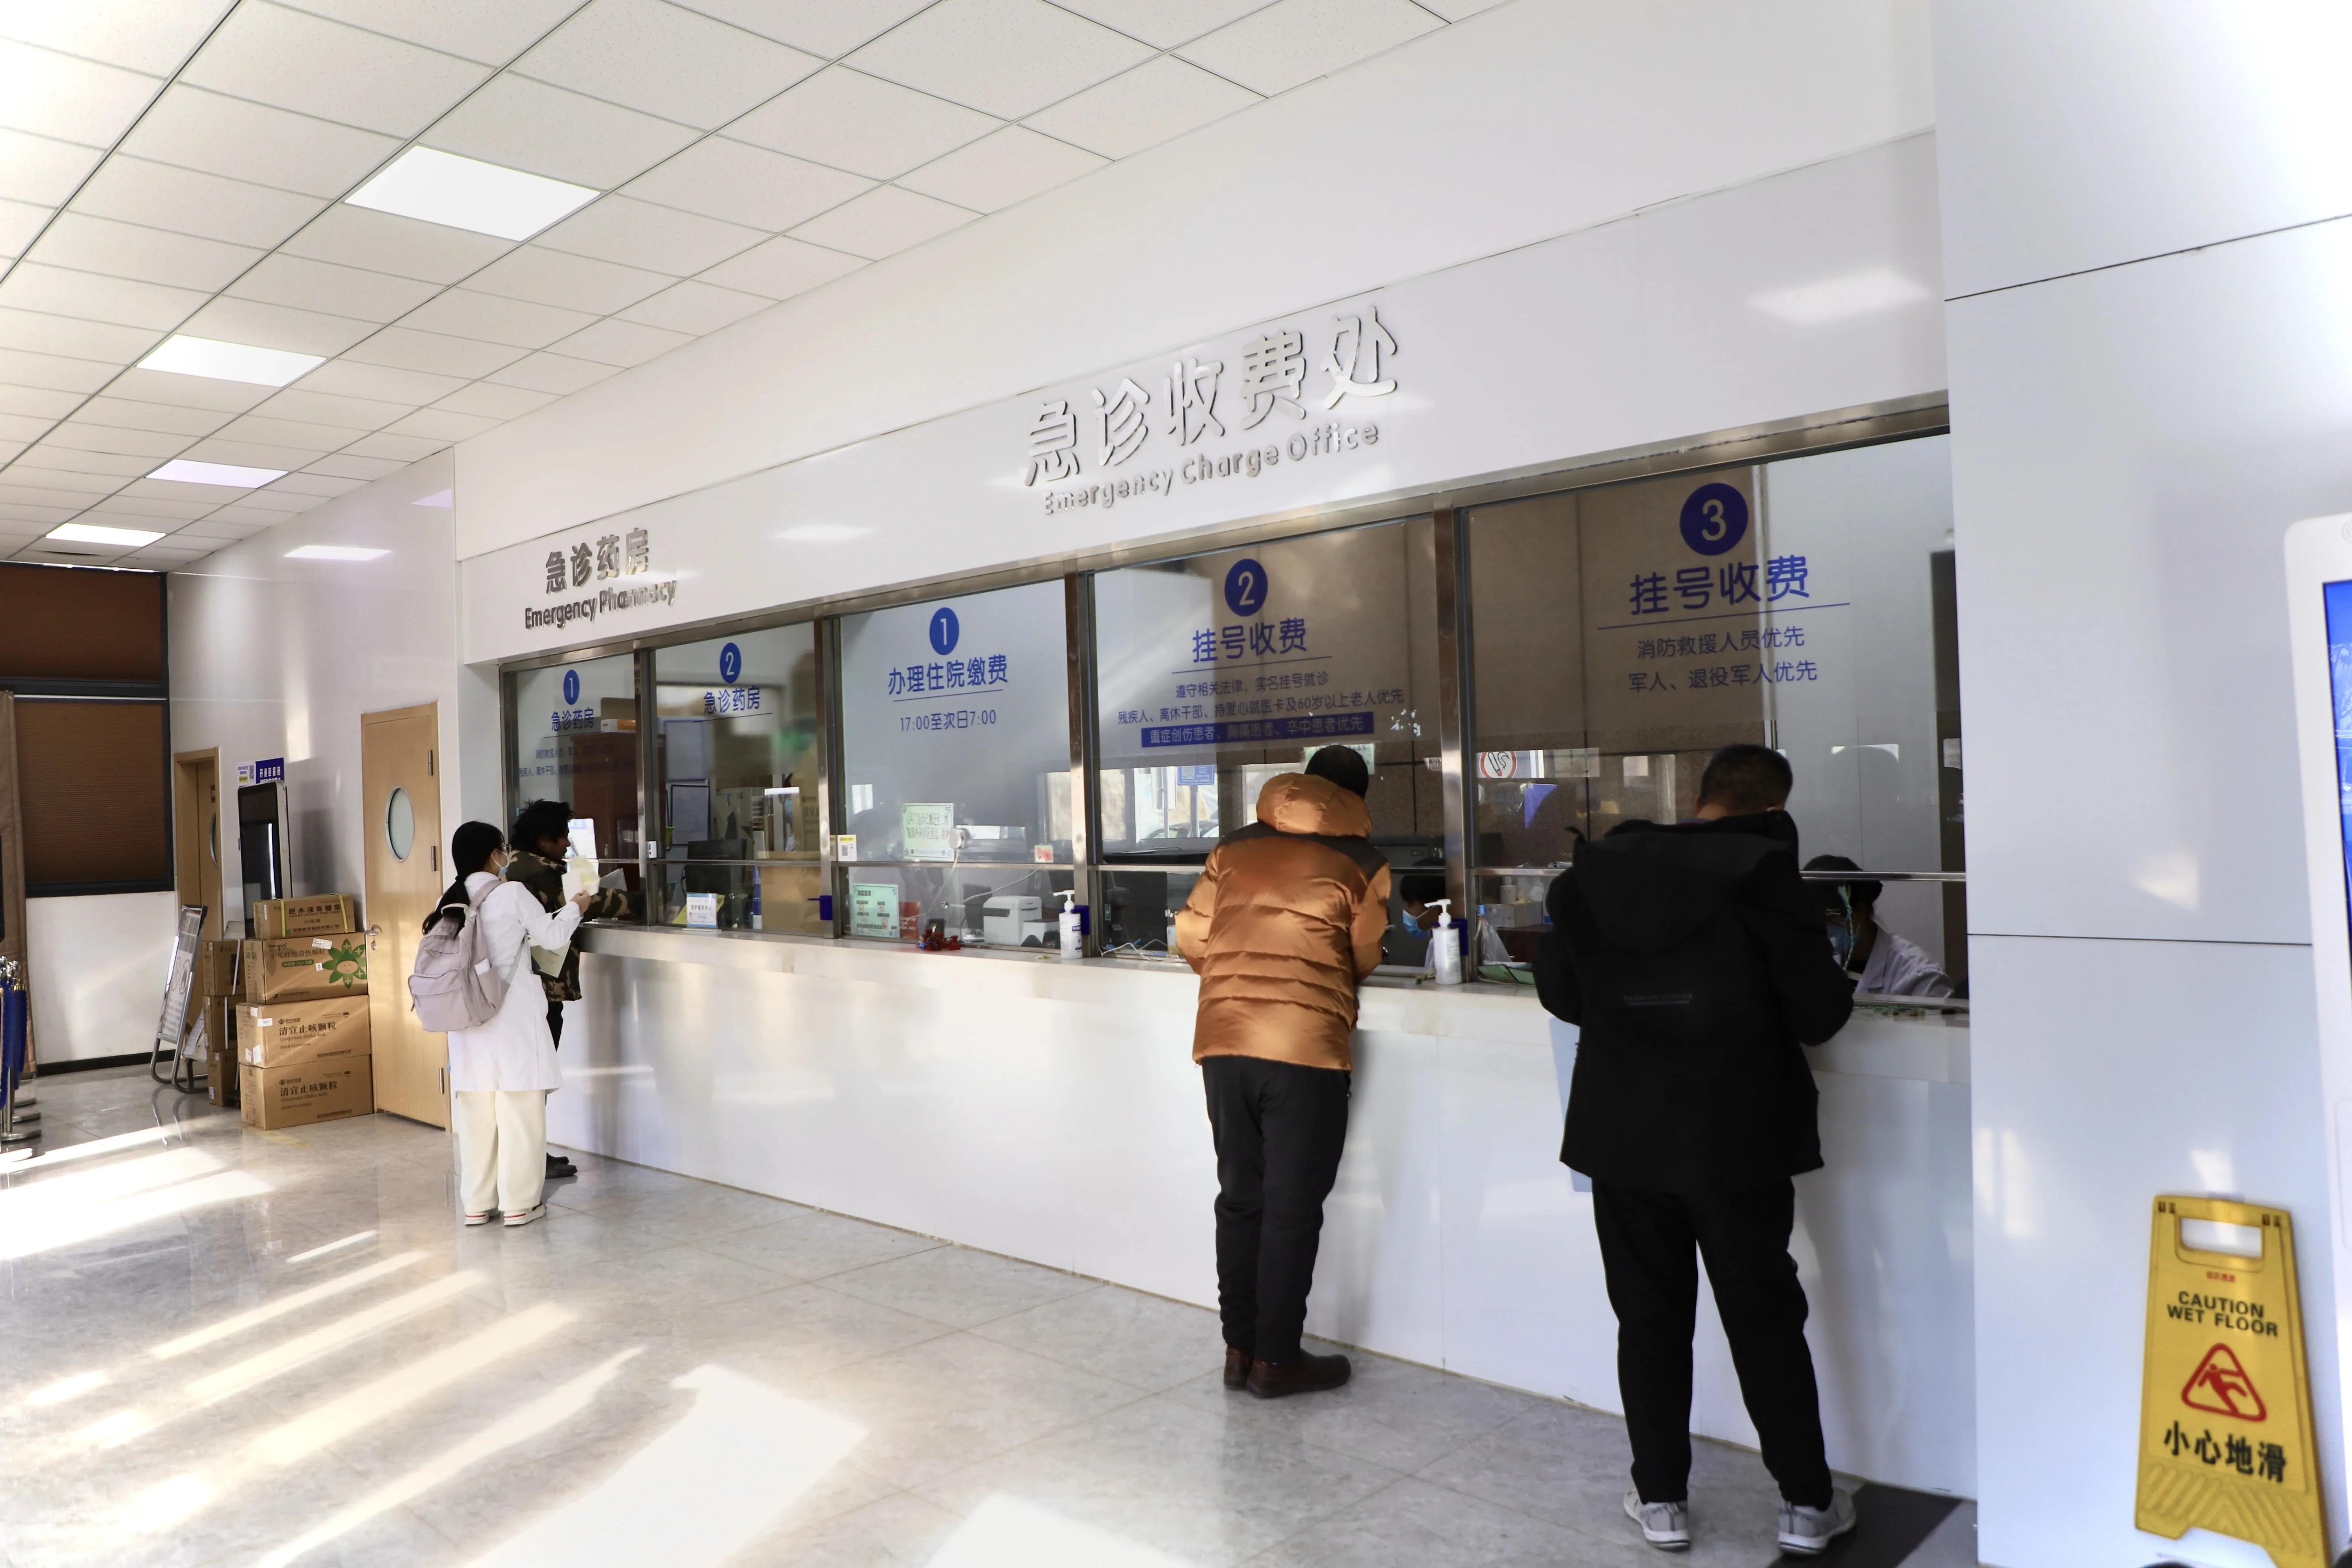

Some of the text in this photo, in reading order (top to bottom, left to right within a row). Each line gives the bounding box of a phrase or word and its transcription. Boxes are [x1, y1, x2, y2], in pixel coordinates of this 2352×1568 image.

[1024, 305, 1398, 487] 急诊收费处
[1043, 421, 1378, 515] Emergency Charge Office
[1701, 499, 1726, 541] 3
[545, 527, 649, 595] 急诊药房
[1238, 571, 1255, 606] 2
[1629, 554, 1810, 615] 挂号收费
[525, 580, 677, 629] Emergency Pharmacy
[940, 617, 947, 646] 1
[1192, 617, 1307, 663] 挂号收费
[1637, 626, 1805, 659] 消防救援人员优先
[725, 651, 735, 676] 2
[888, 654, 1008, 695] 办理住院缴费
[1628, 660, 1818, 693] 军人、退役军人优先
[569, 677, 573, 698] 1
[703, 684, 761, 714] 急诊药房
[551, 706, 594, 732] 急诊药房
[900, 709, 997, 731] 17:00至次日7:00
[279, 1021, 336, 1036] 清宣止咳颗粒
[2167, 1304, 2278, 1337] WET FLOOR
[2178, 1291, 2264, 1319] CAUTION
[2164, 1419, 2288, 1483] 小心地滑
